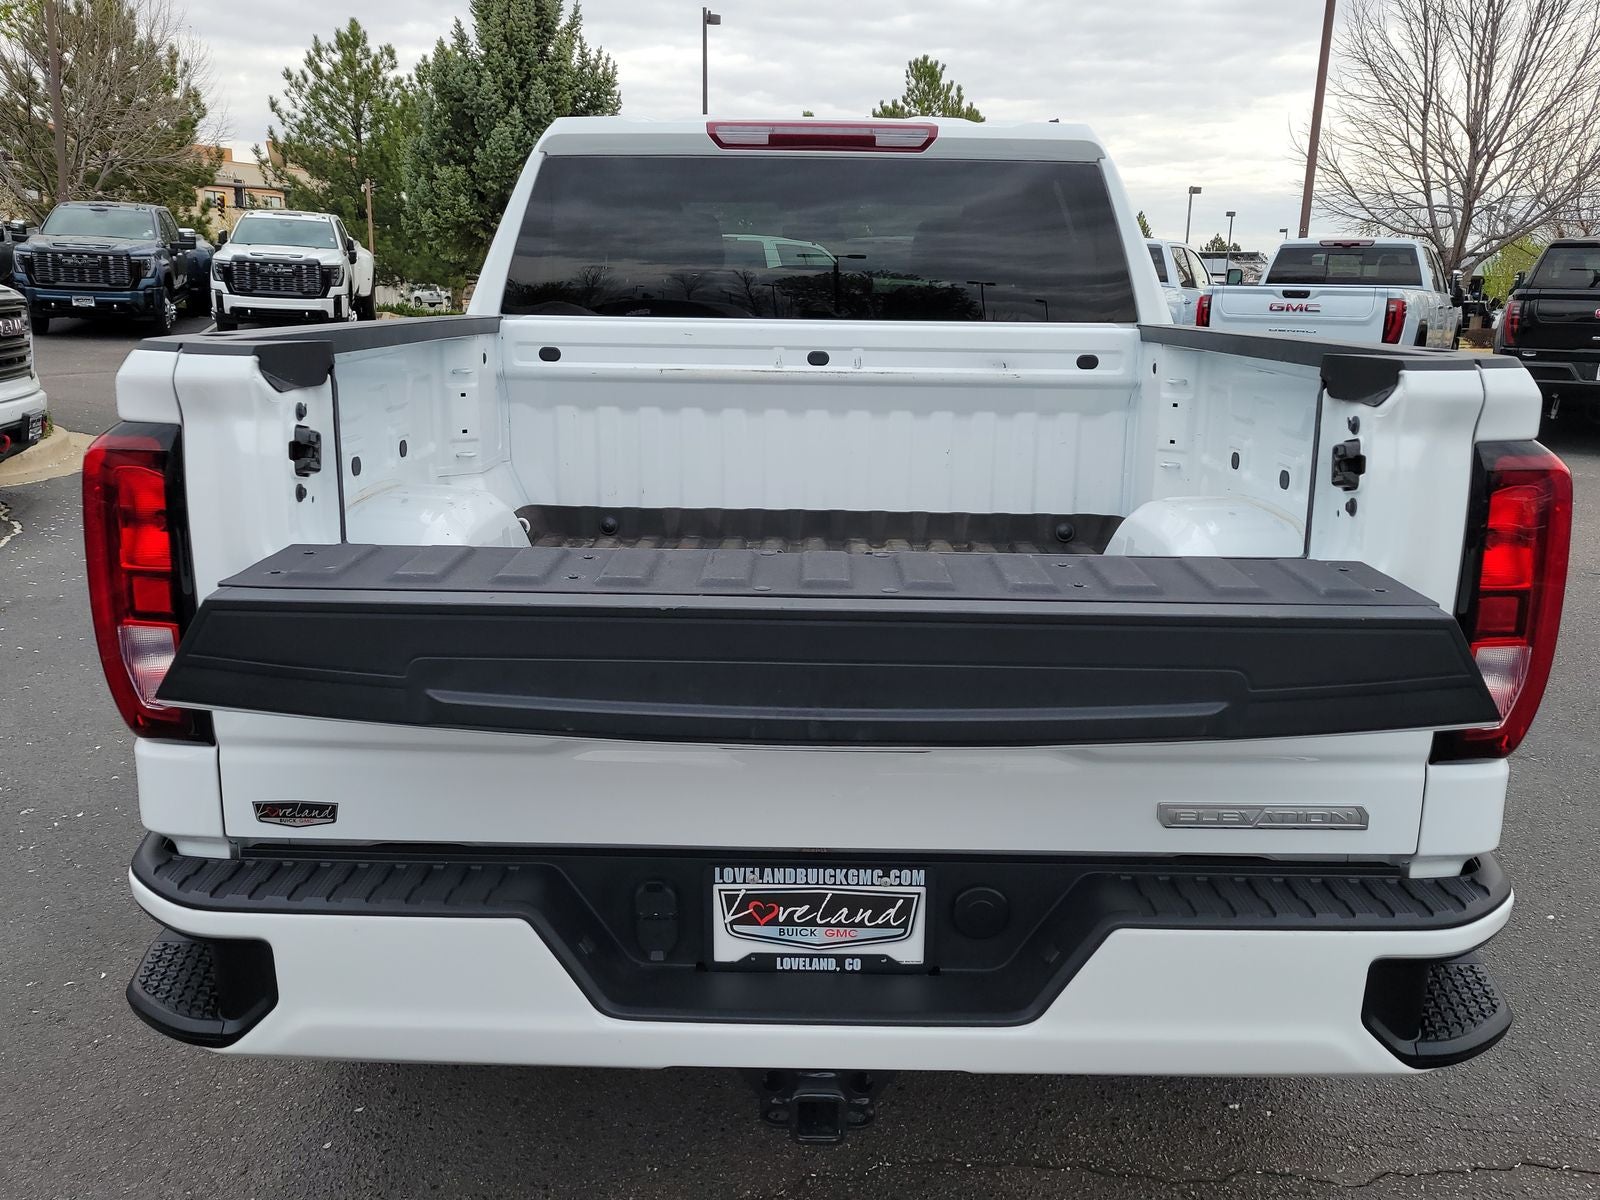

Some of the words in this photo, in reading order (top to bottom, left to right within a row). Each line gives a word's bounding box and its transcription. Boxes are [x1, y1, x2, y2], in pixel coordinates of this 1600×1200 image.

[1269, 302, 1321, 313] GMC
[257, 802, 334, 818] Loveland
[1174, 808, 1355, 825] ELEVATION
[714, 867, 925, 886] LOVELANDBUICKGMCCOM
[724, 889, 906, 927] Loveland
[778, 928, 817, 937] BUICK
[824, 928, 858, 938] GMC
[776, 957, 840, 972] LOVELAND,
[844, 958, 862, 971] CO
